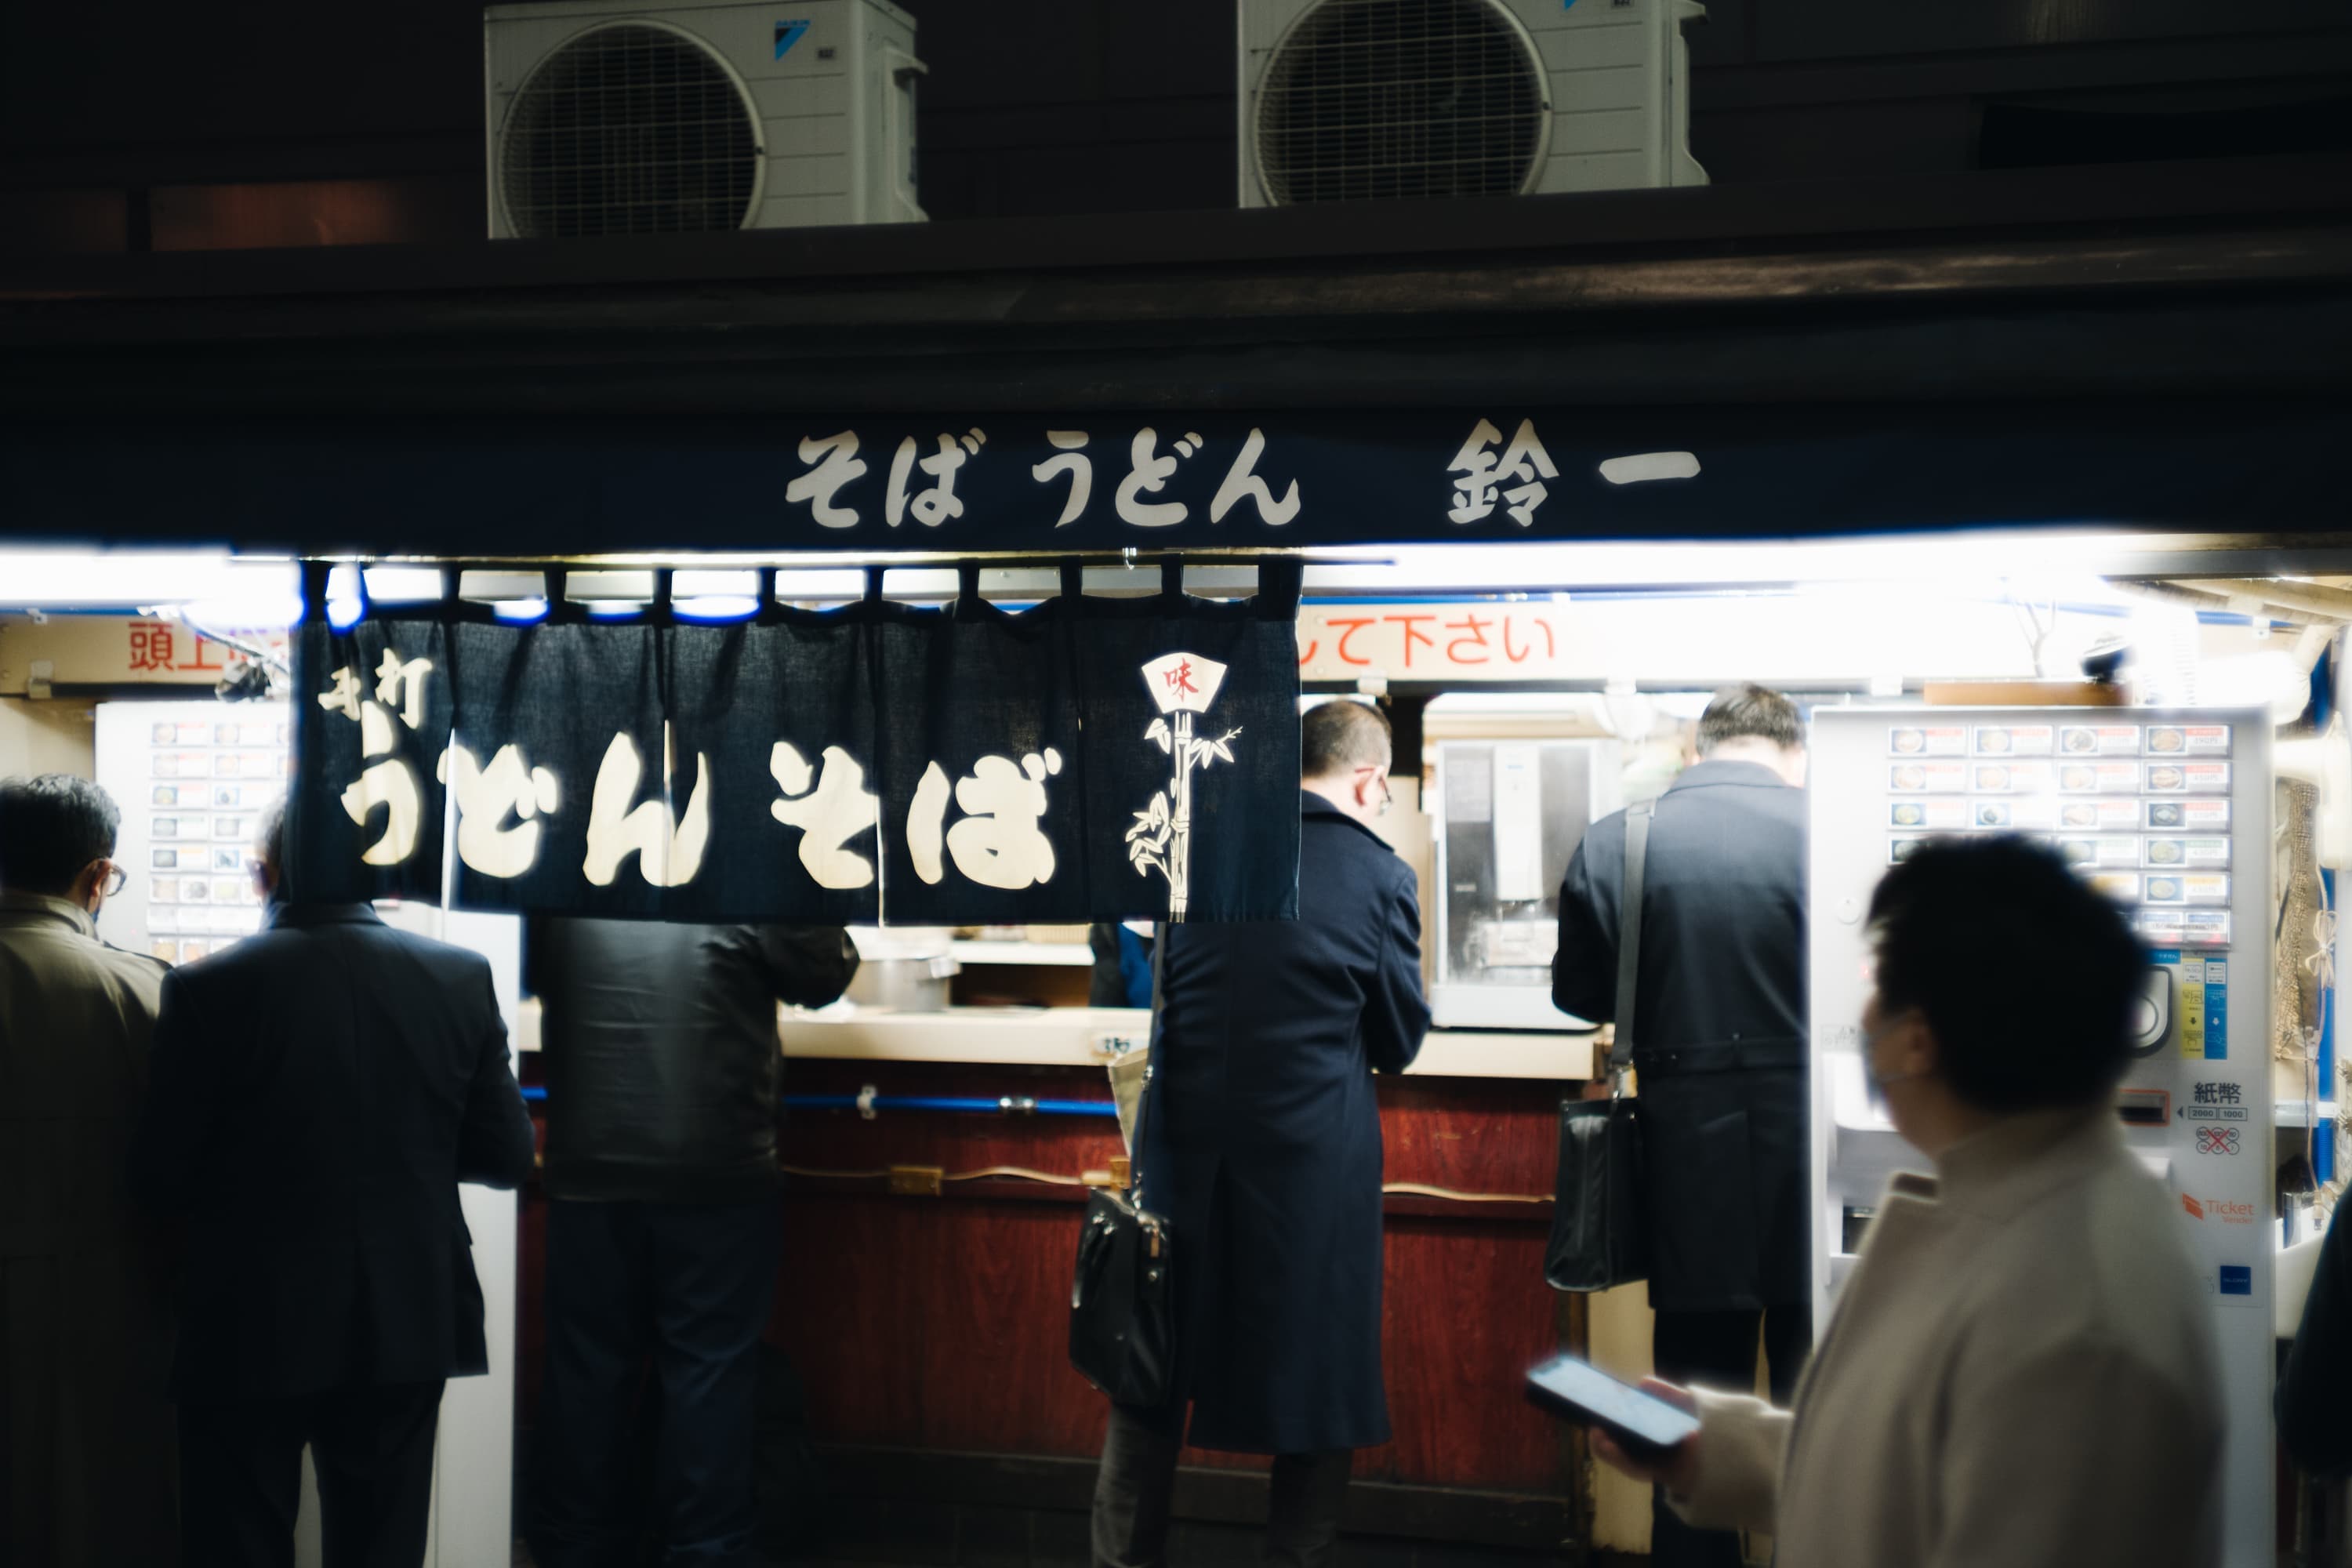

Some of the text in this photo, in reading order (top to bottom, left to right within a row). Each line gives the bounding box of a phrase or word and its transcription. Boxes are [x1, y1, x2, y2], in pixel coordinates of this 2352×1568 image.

[786, 418, 1700, 528] そば うどん 鈴一
[1162, 657, 1199, 702] 味
[340, 701, 1062, 890] うどん そば
[2194, 1082, 2241, 1104] 紙幣
[2206, 1200, 2255, 1216] Ticket
